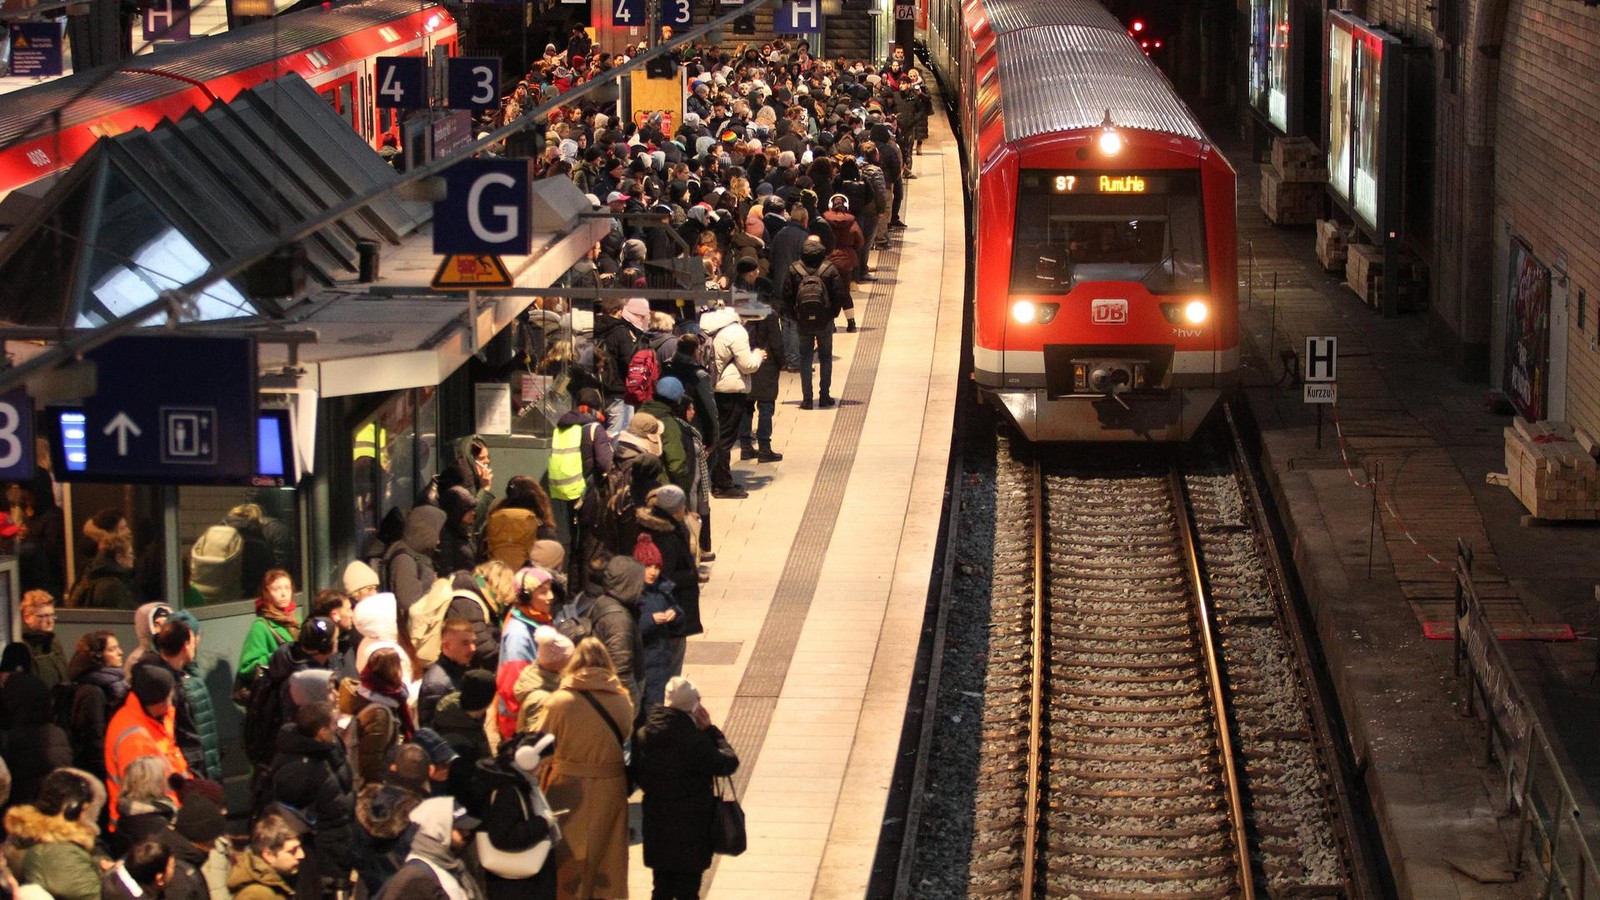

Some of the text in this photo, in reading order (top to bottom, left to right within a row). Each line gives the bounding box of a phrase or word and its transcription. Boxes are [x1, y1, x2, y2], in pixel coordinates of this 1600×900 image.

[615, 0, 631, 22] 4
[675, 0, 691, 23] 3
[791, 0, 817, 28] H
[898, 5, 915, 19] öA
[380, 65, 404, 102] 4
[471, 66, 494, 104] 3
[1055, 175, 1075, 191] S7
[467, 172, 519, 244] G
[1095, 303, 1125, 321] DB
[1309, 340, 1334, 378] H
